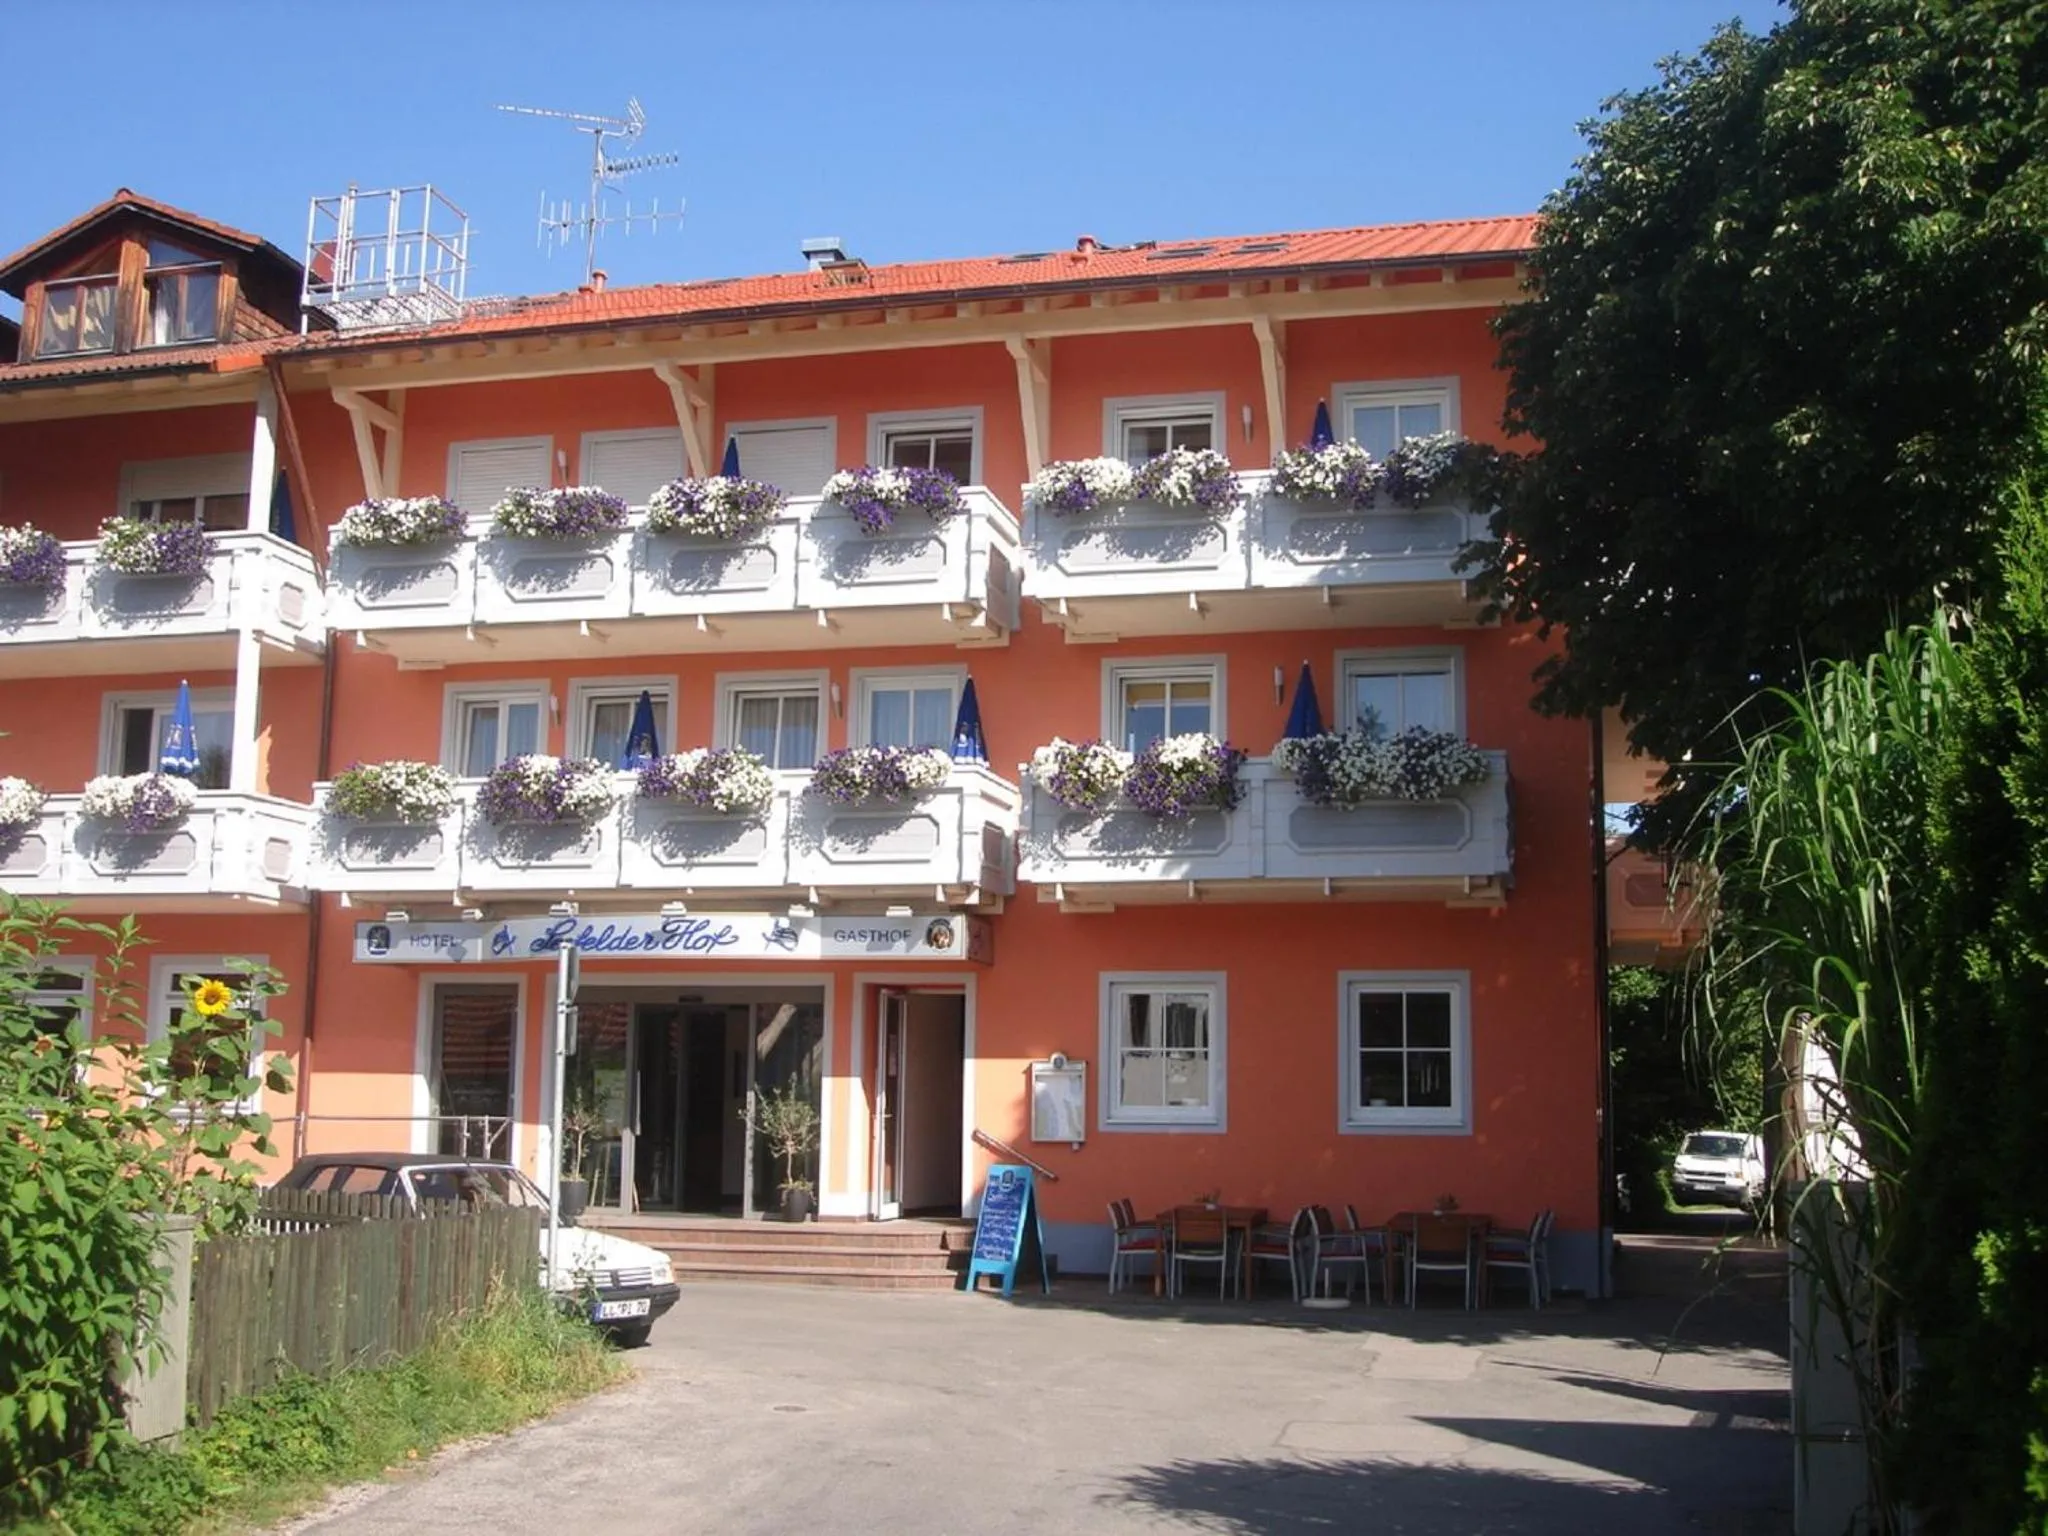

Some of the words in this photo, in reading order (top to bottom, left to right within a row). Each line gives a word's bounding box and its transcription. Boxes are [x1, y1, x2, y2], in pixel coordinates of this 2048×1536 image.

[410, 934, 457, 948] HOTEL
[661, 918, 740, 954] Hof
[833, 928, 912, 943] GASTHOF
